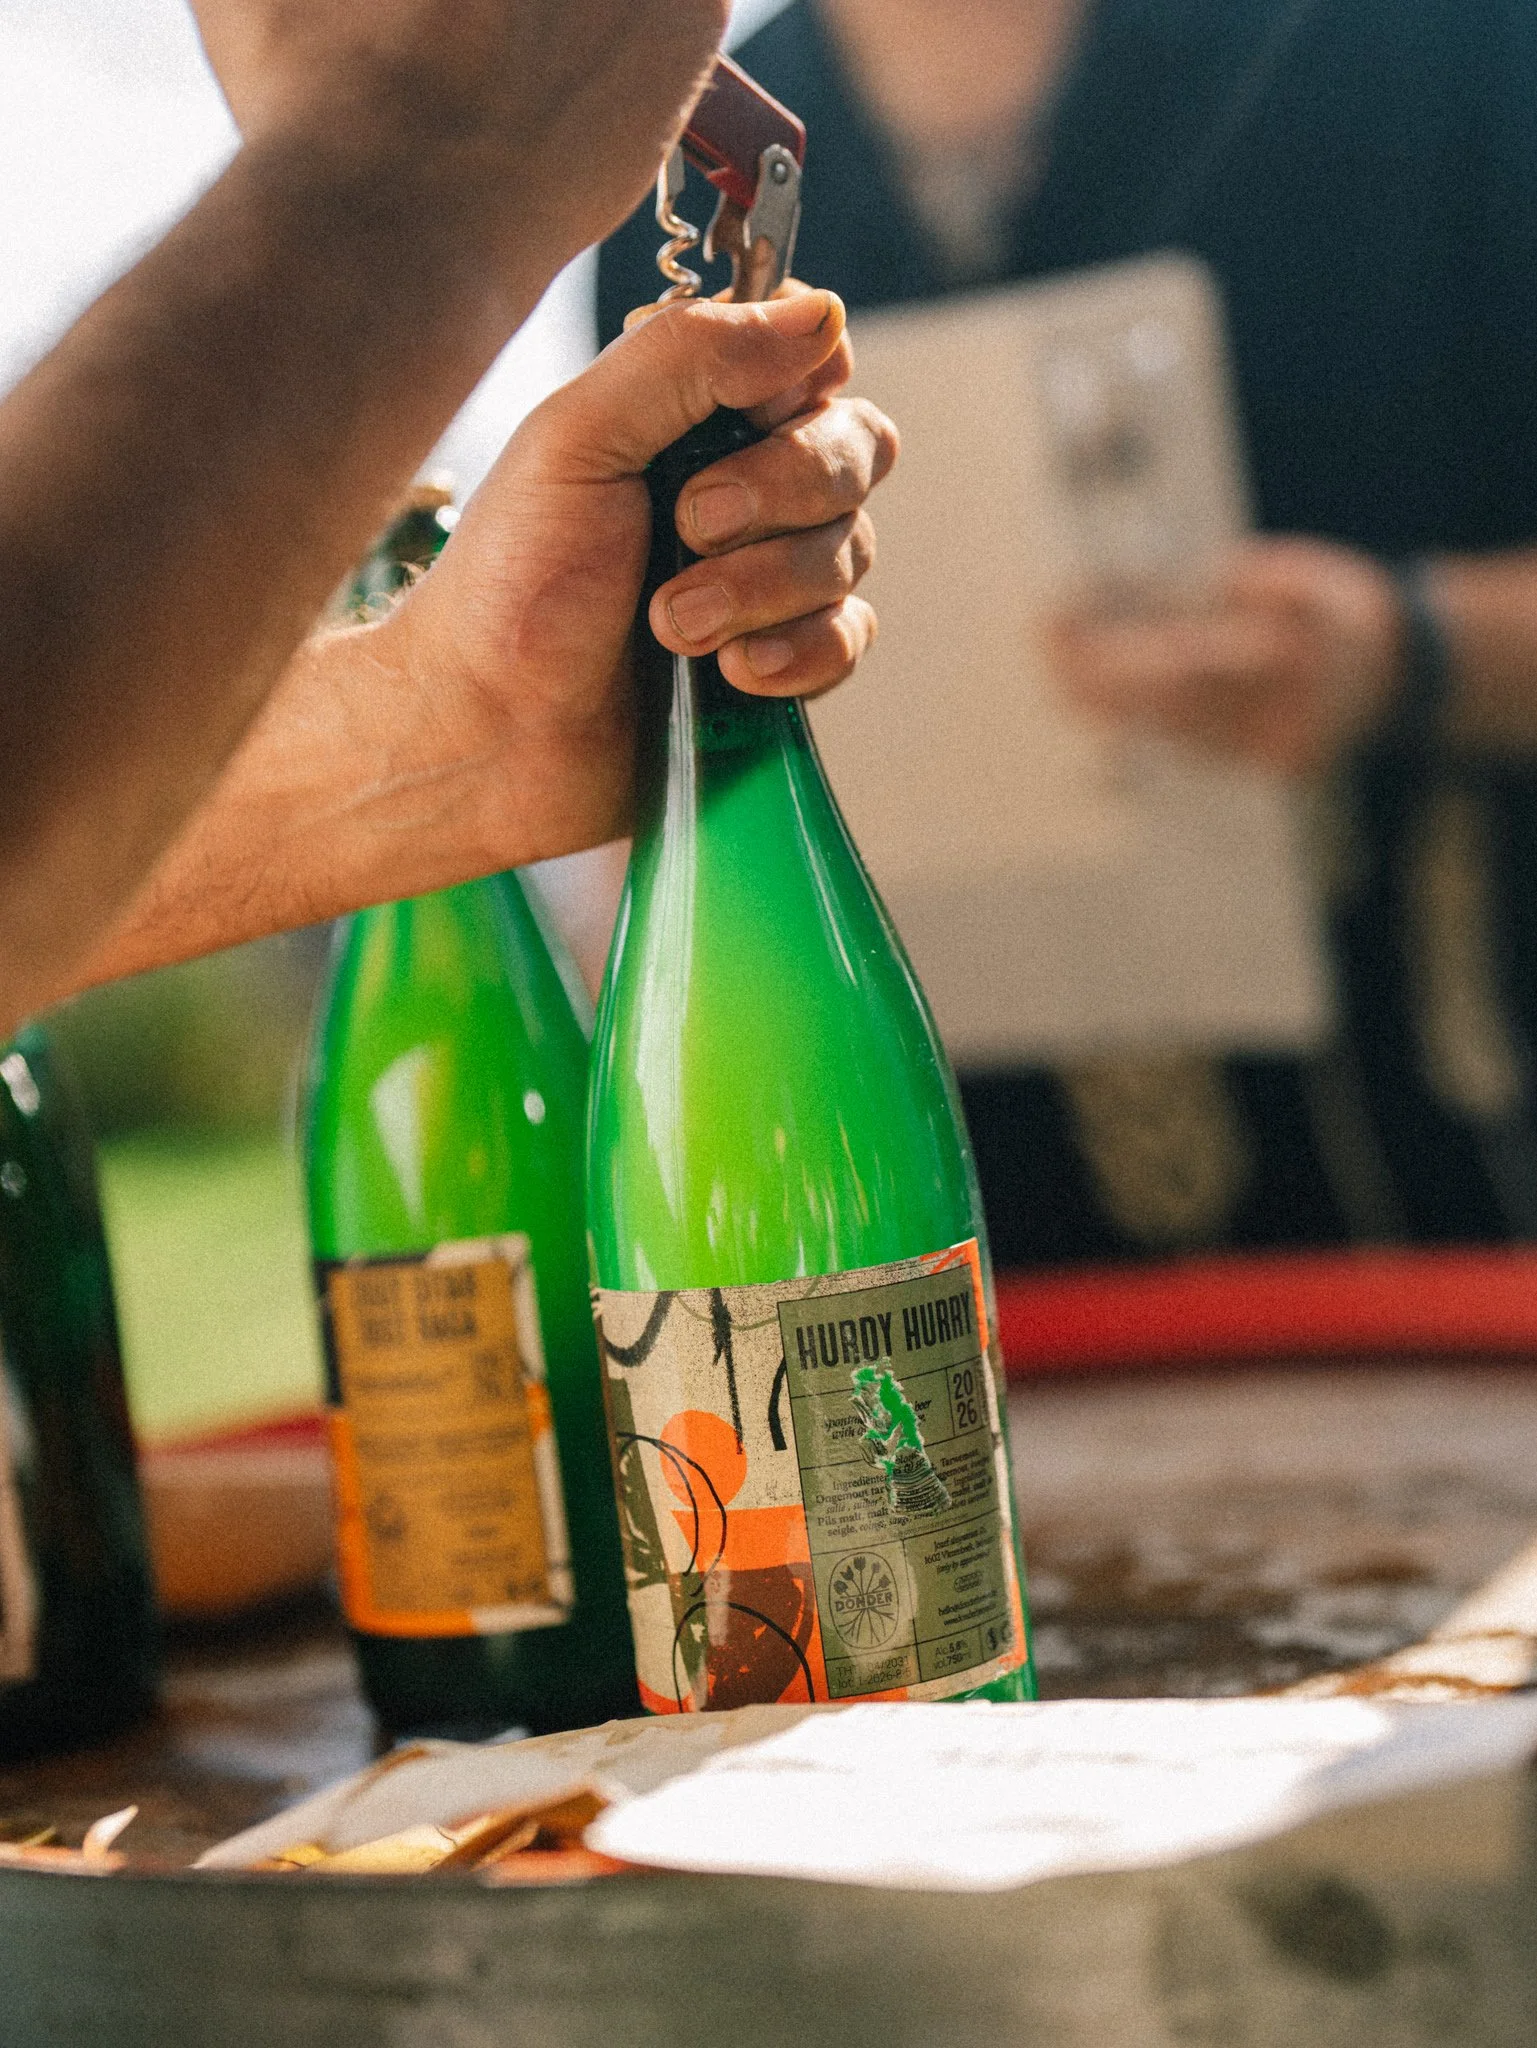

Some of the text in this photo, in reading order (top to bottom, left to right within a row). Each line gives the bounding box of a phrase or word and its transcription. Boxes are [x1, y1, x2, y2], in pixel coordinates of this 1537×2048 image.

[796, 1291, 971, 1370] HURDY HURRY
[953, 1369, 973, 1400] 20
[957, 1399, 977, 1428] 26
[815, 1489, 869, 1504] Ongemout
[817, 1515, 837, 1526] Pils
[834, 1591, 893, 1612] DONDER
